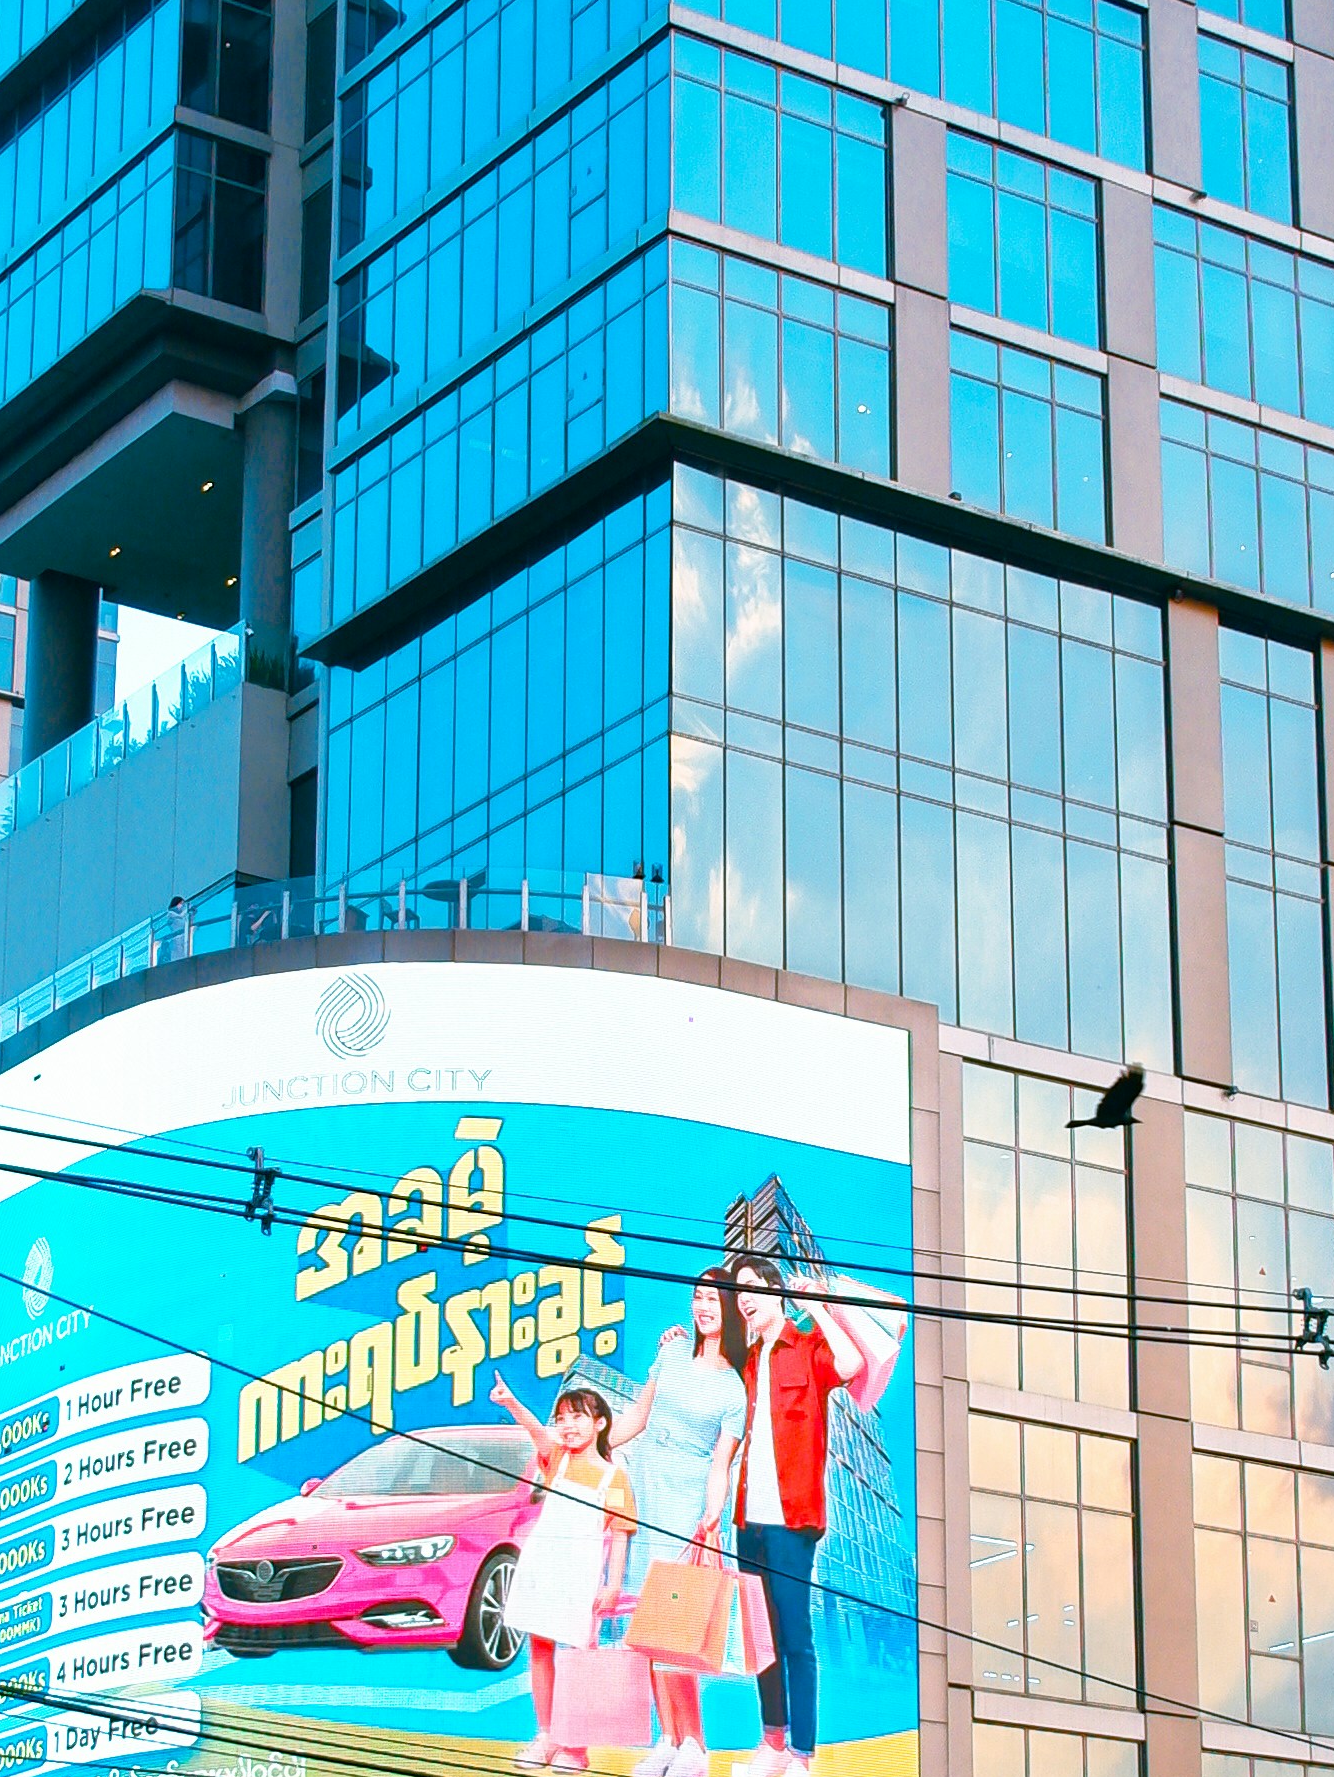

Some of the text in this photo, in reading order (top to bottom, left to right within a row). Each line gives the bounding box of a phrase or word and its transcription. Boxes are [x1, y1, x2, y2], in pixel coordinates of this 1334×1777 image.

[222, 1067, 492, 1110] JUNCTION CITY
[56, 1304, 95, 1337] CITY
[65, 1399, 73, 1422] 1
[78, 1385, 123, 1416] Hour
[129, 1374, 182, 1404] Free
[64, 1463, 73, 1486] 2
[78, 1450, 135, 1481] Hours
[143, 1435, 198, 1466] Free
[61, 1528, 70, 1552] 3
[76, 1516, 132, 1547] Hours
[140, 1503, 195, 1533] Free
[13, 1597, 43, 1619] Ticket
[58, 1572, 193, 1618] 3 Hours Free
[56, 1661, 66, 1684] 4
[73, 1651, 130, 1681] Hours
[138, 1639, 193, 1670] Free
[54, 1730, 60, 1753] 1
[67, 1725, 101, 1750] Day
[108, 1717, 159, 1741] Free
